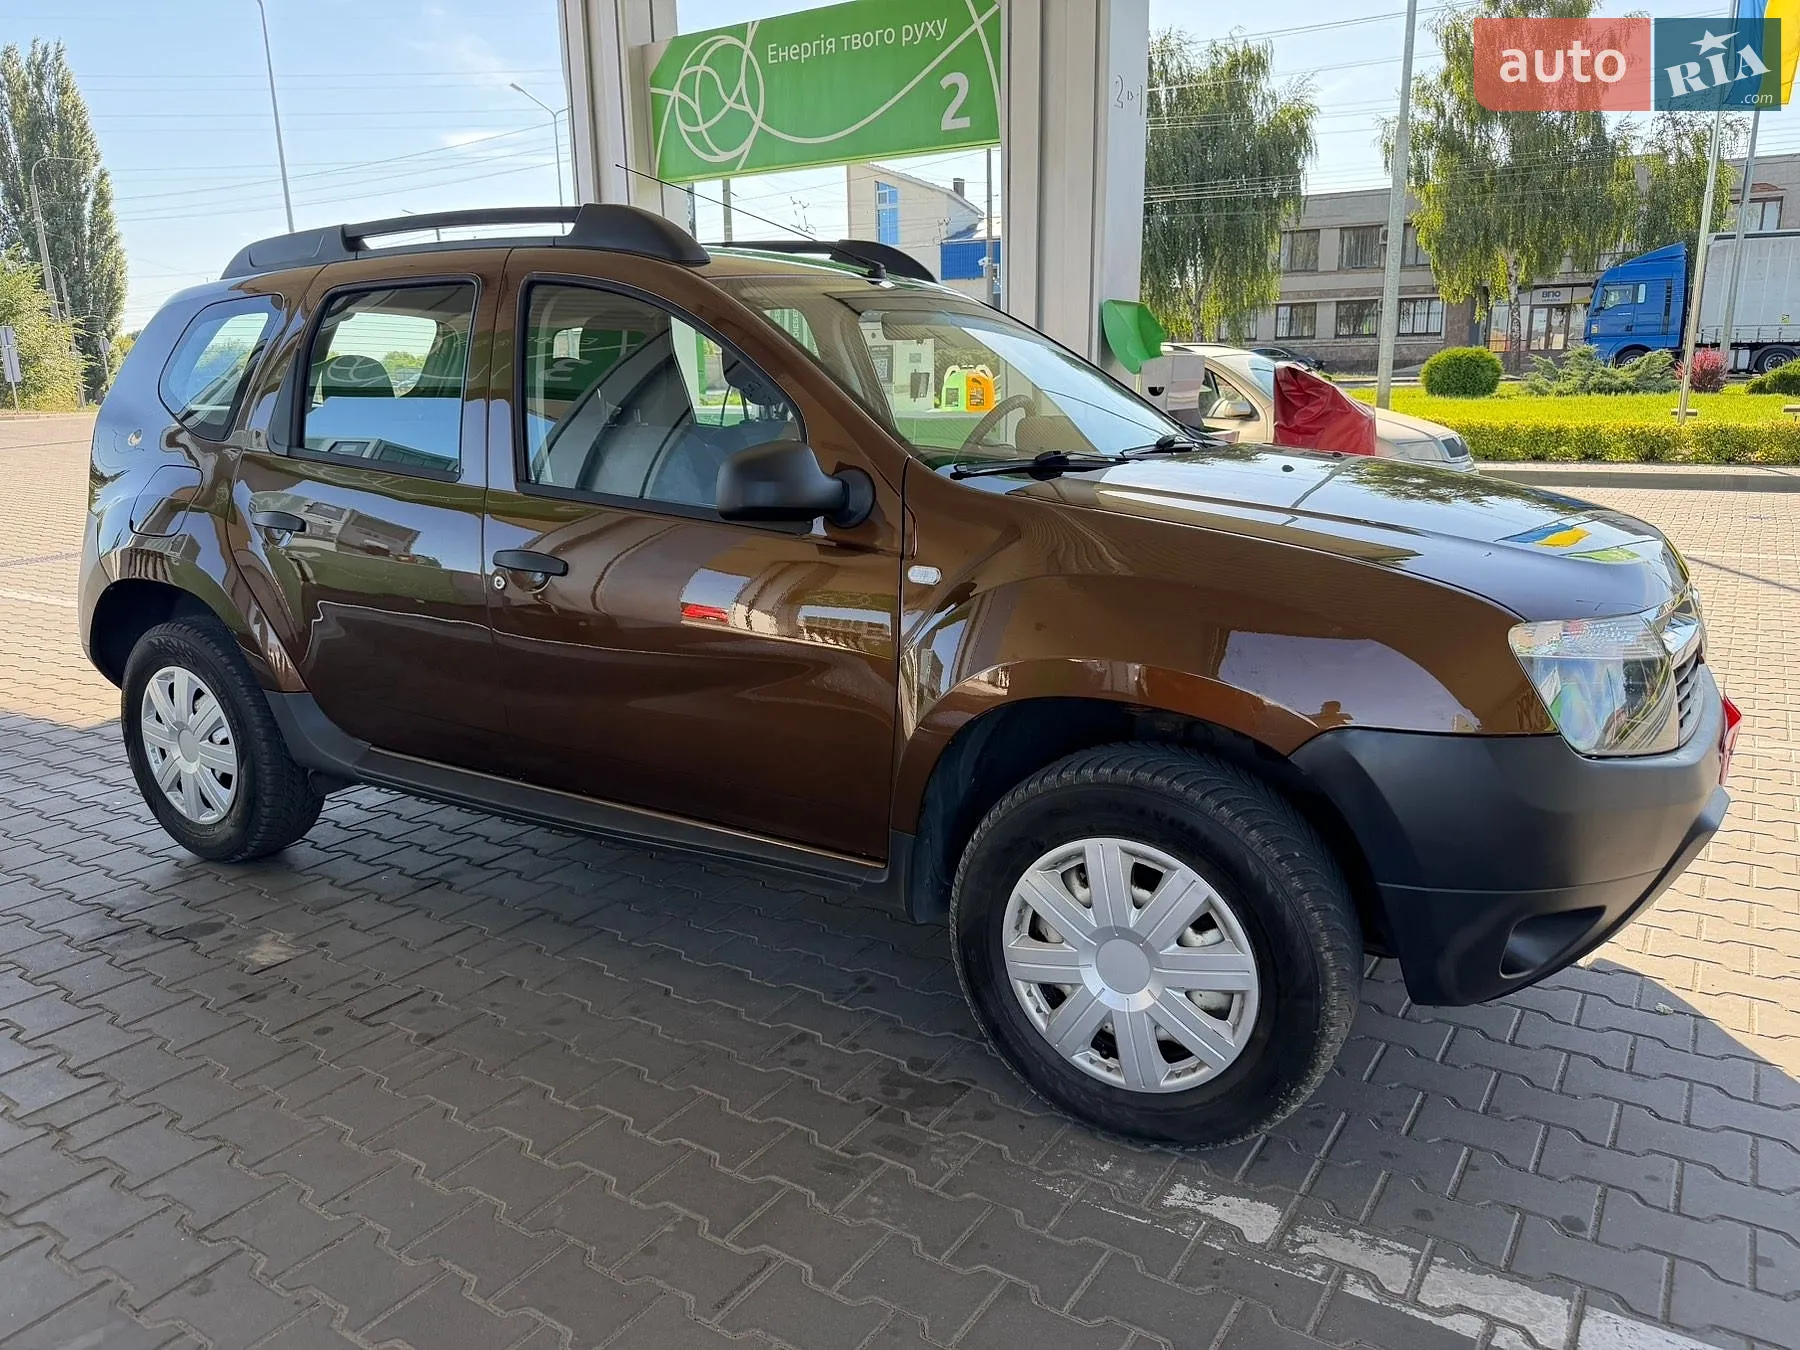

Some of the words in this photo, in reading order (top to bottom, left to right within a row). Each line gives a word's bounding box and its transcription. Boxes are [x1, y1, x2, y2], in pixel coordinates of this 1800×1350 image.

[768, 34, 836, 64] Енергія
[841, 27, 896, 52] твого
[902, 18, 948, 47] руху
[939, 71, 971, 131] 2
